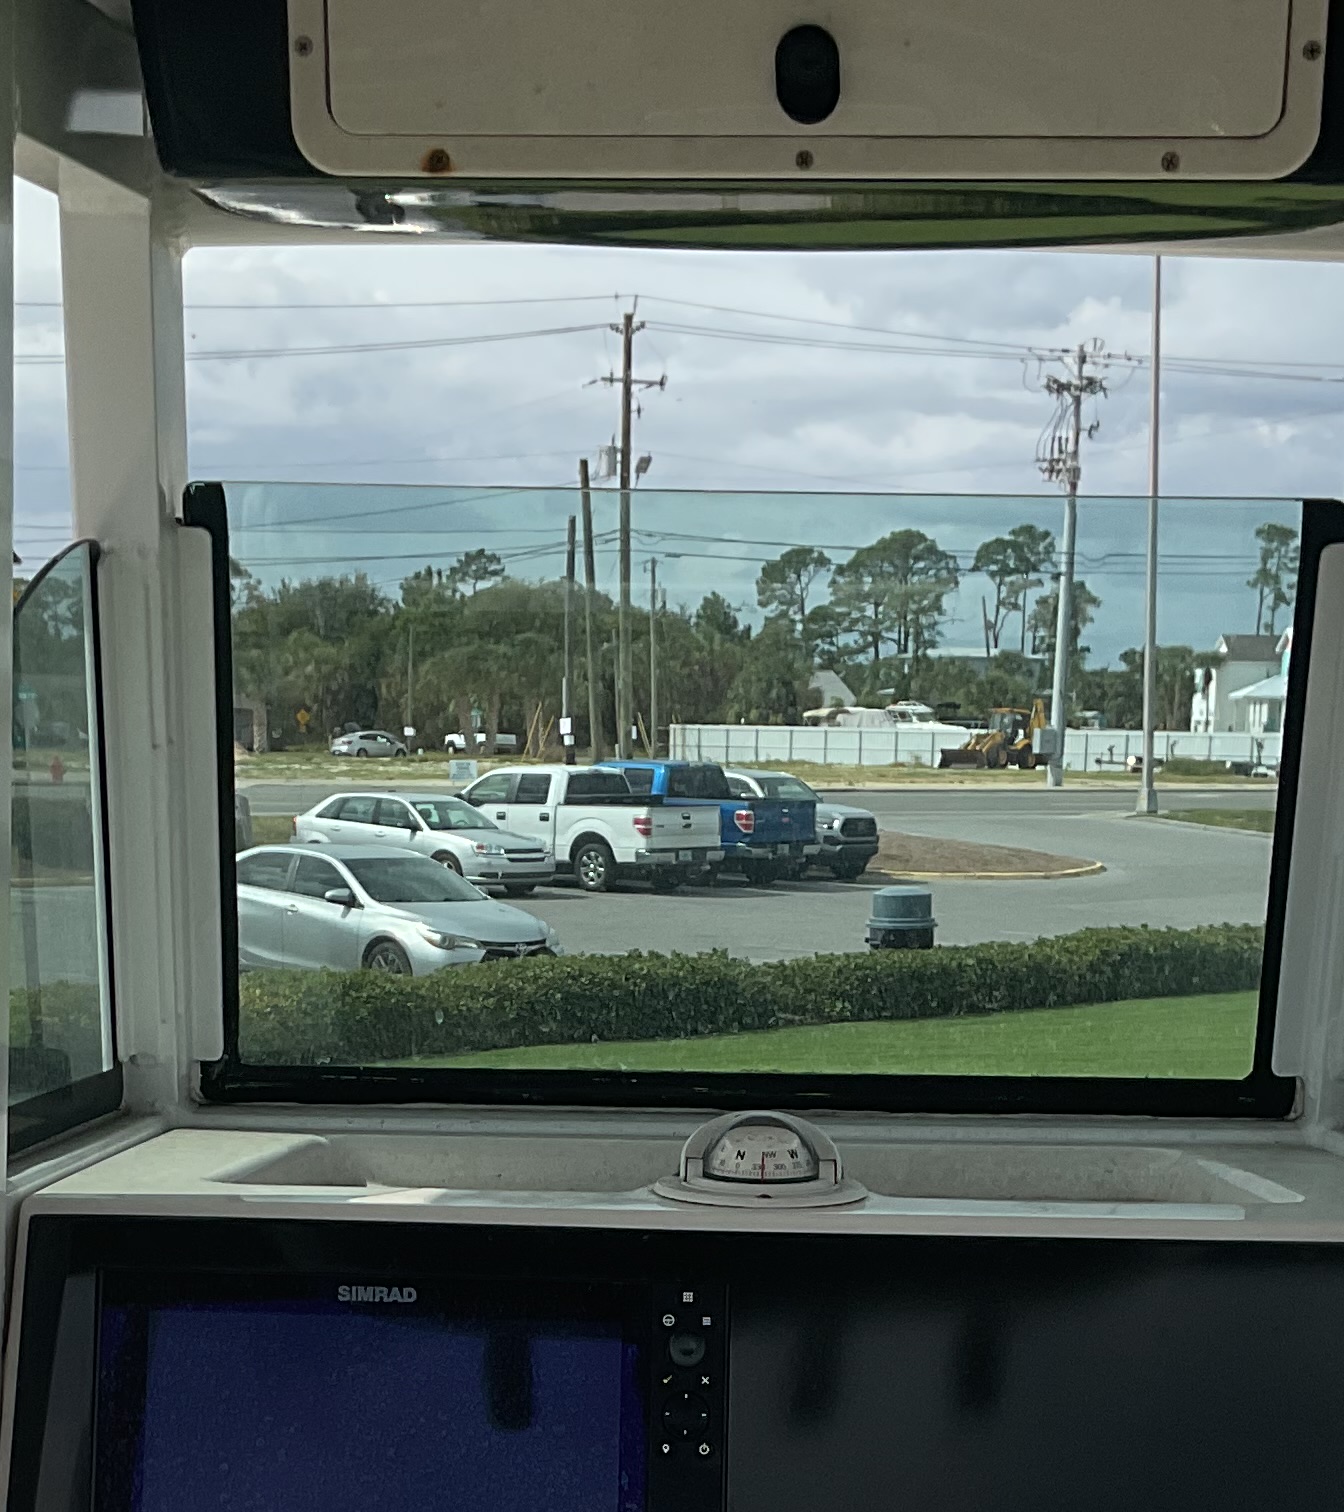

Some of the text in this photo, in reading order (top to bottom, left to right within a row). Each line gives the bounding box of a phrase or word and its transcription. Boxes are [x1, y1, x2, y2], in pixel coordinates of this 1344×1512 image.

[736, 1149, 746, 1161] N
[787, 1148, 799, 1160] W
[337, 1285, 418, 1303] SIMRAD
